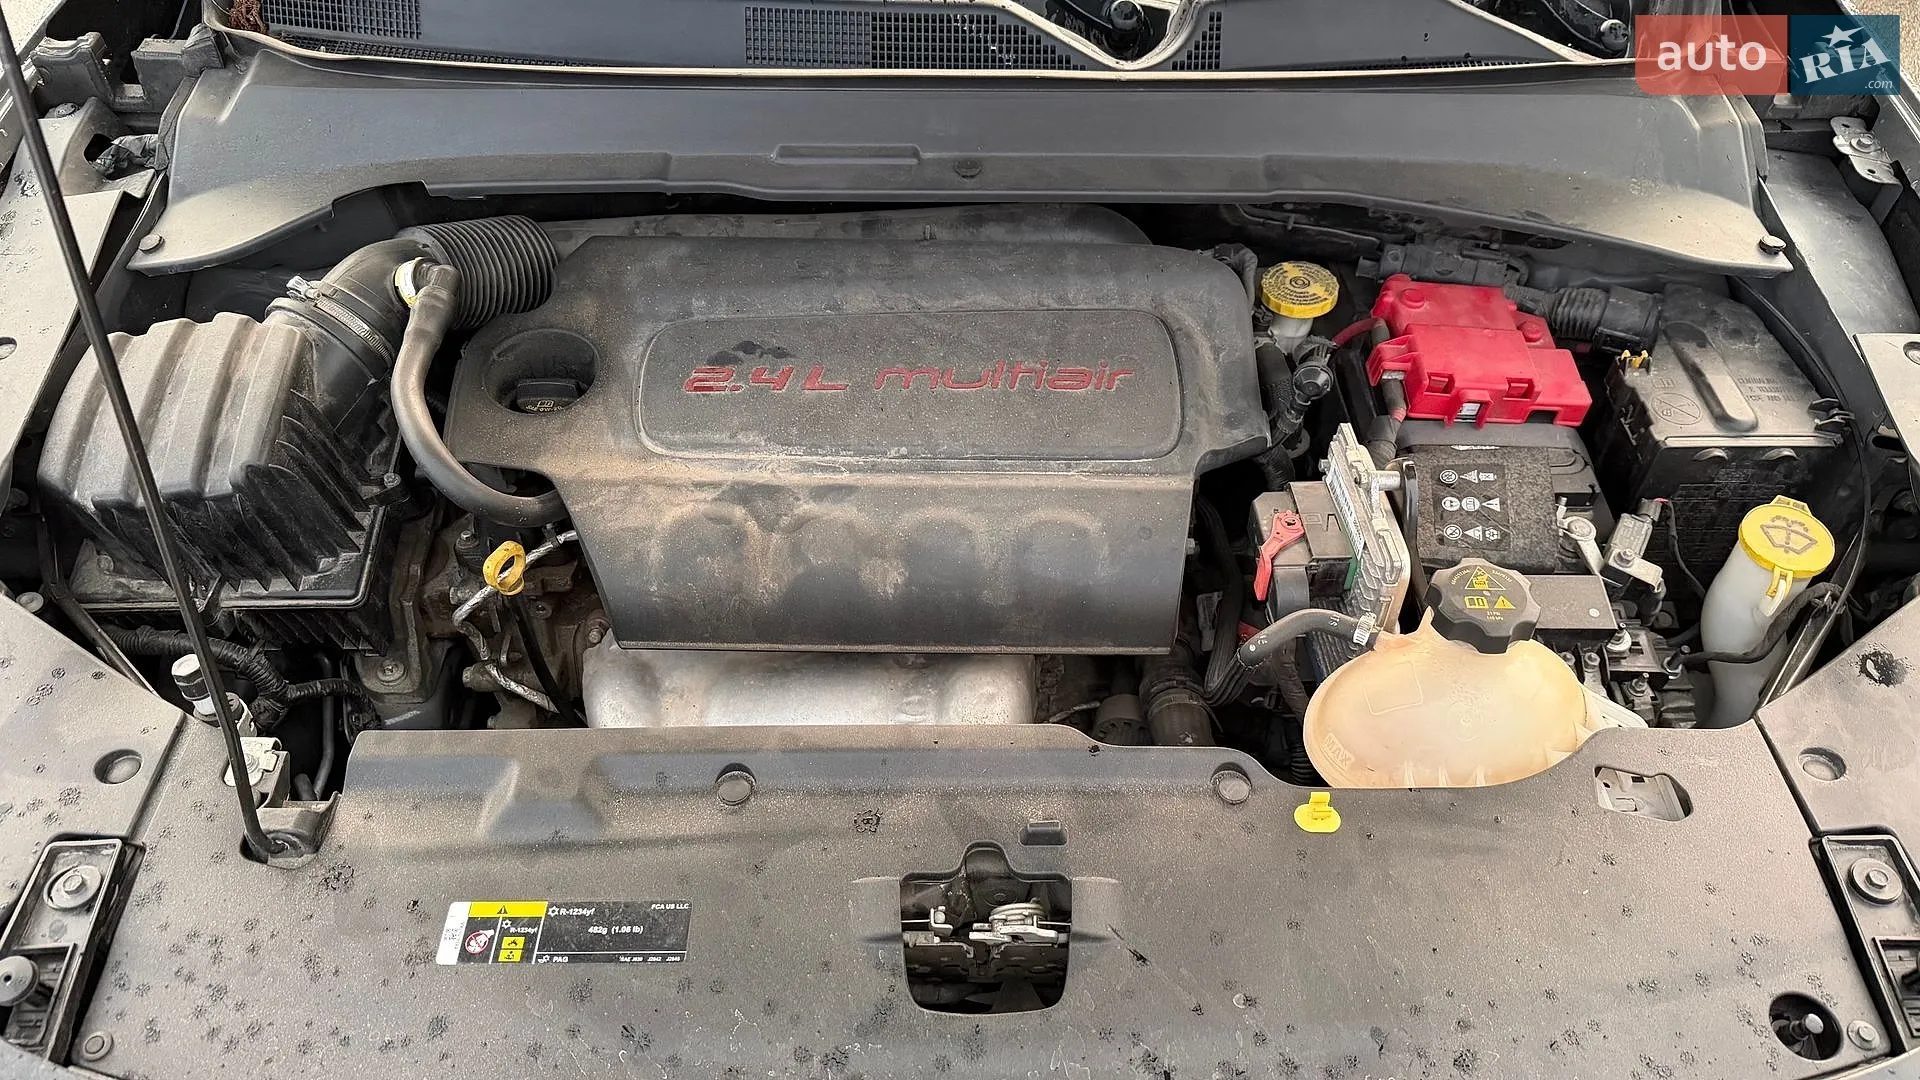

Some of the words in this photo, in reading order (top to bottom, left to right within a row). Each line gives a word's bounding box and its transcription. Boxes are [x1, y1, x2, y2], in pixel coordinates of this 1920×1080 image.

[874, 359, 1136, 392] multiair
[560, 907, 595, 917] R-1234yf
[510, 926, 538, 934] R-1234yf
[588, 925, 608, 935] 482g
[632, 925, 643, 935] lb)
